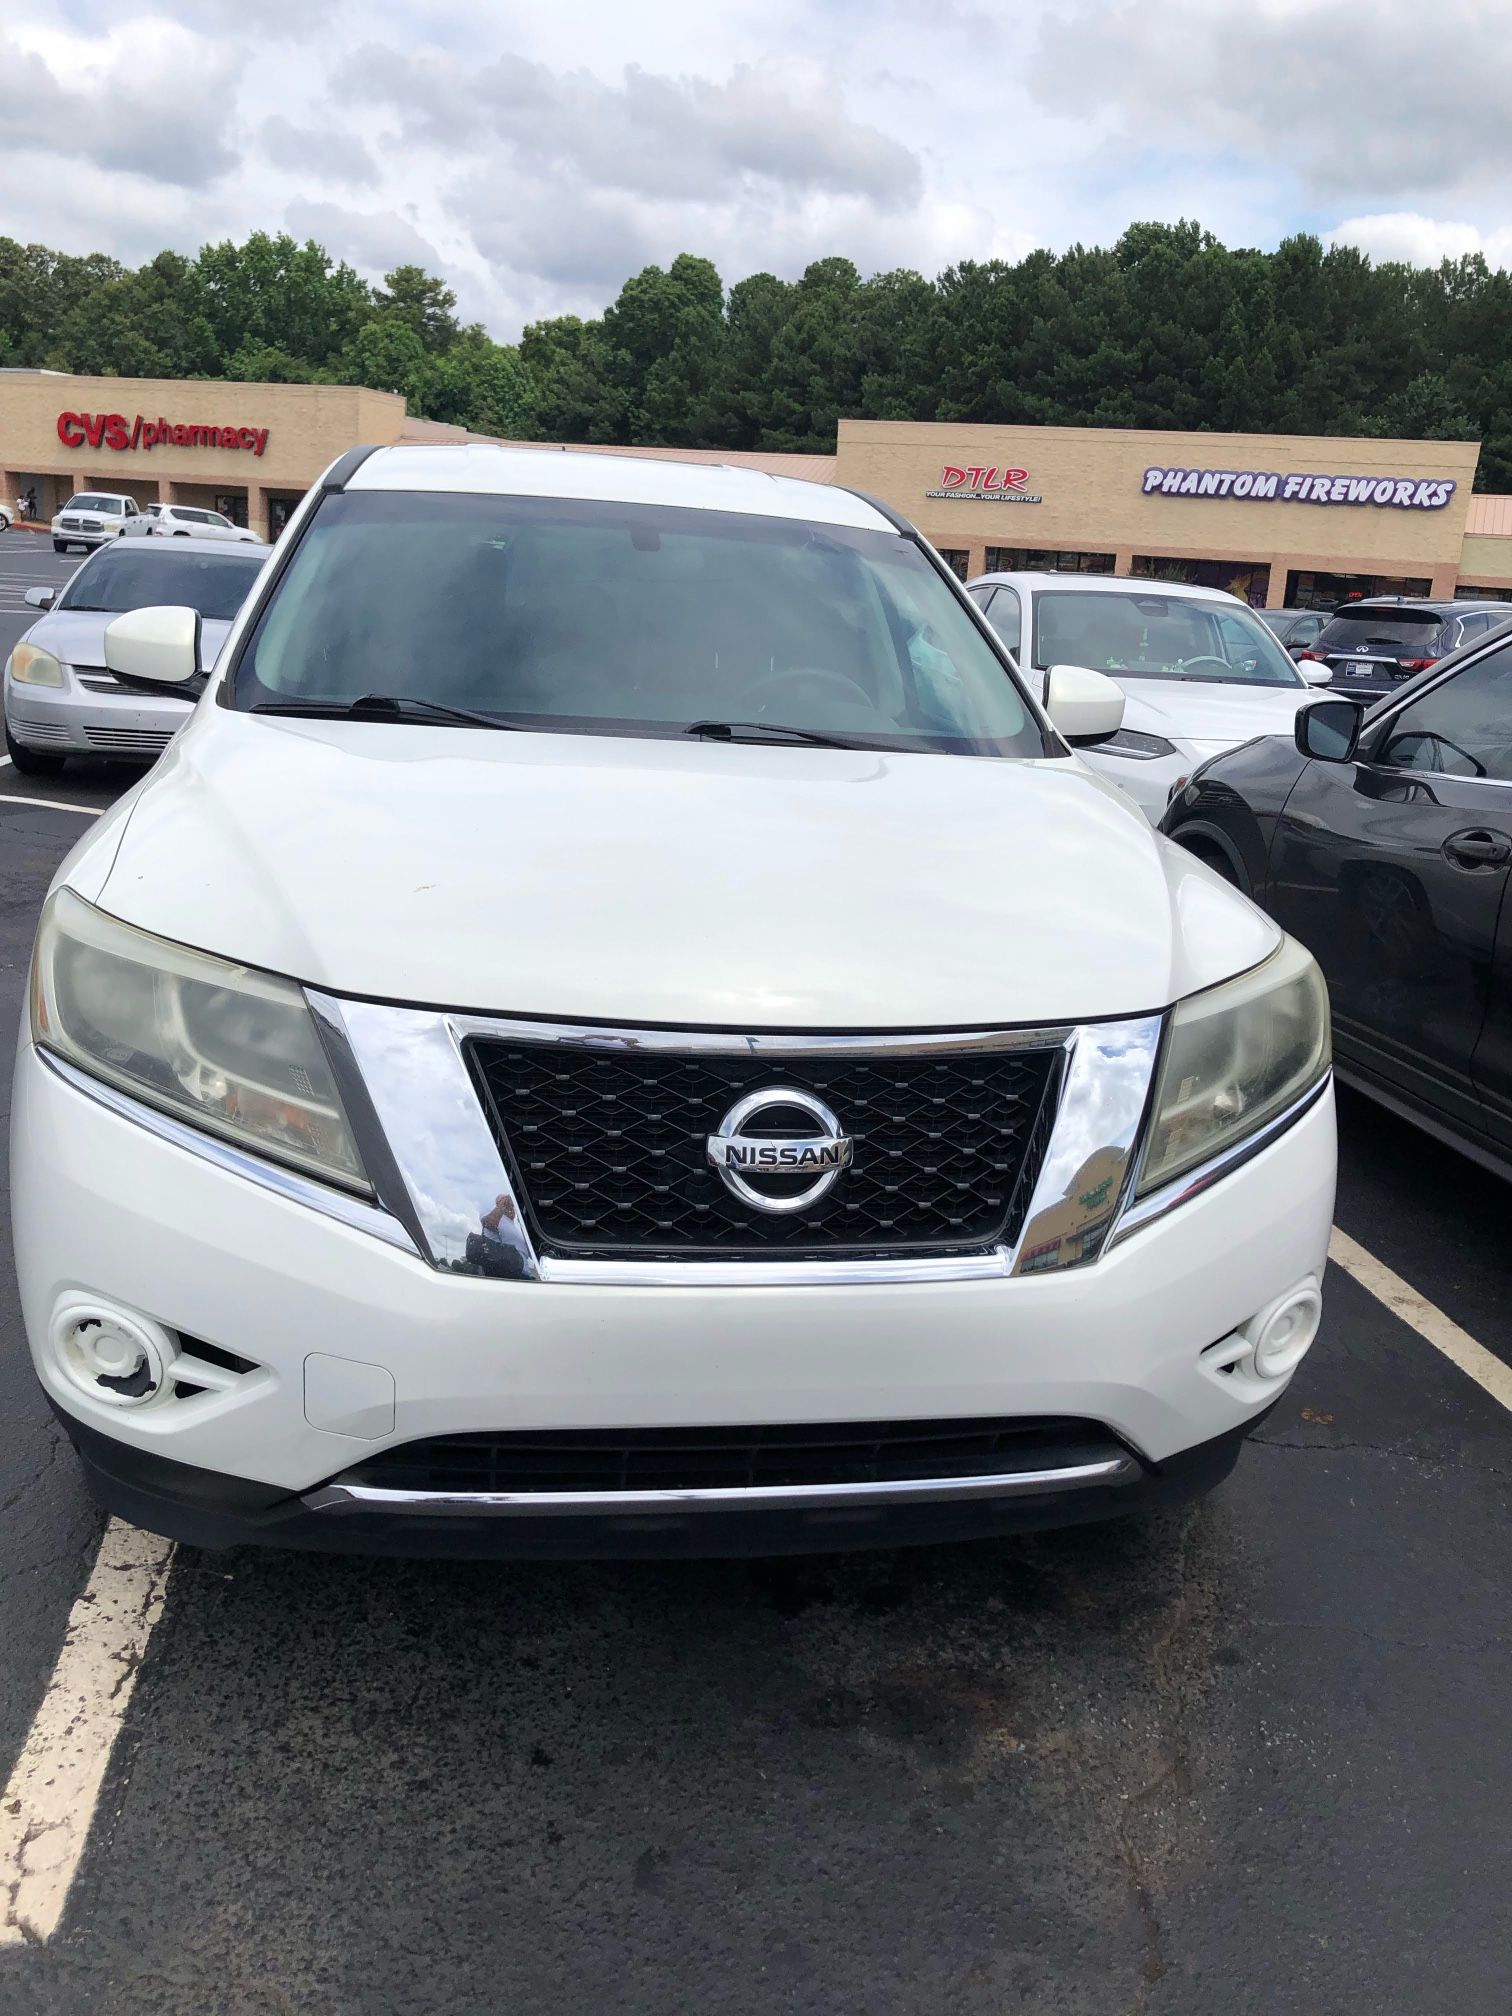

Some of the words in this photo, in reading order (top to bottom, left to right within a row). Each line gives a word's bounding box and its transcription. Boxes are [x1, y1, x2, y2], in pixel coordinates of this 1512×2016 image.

[942, 465, 1029, 492] DTLR
[1144, 469, 1279, 498] PHANTOM
[1284, 475, 1453, 507] FIREWORKS
[725, 1145, 839, 1165] NISSAN
